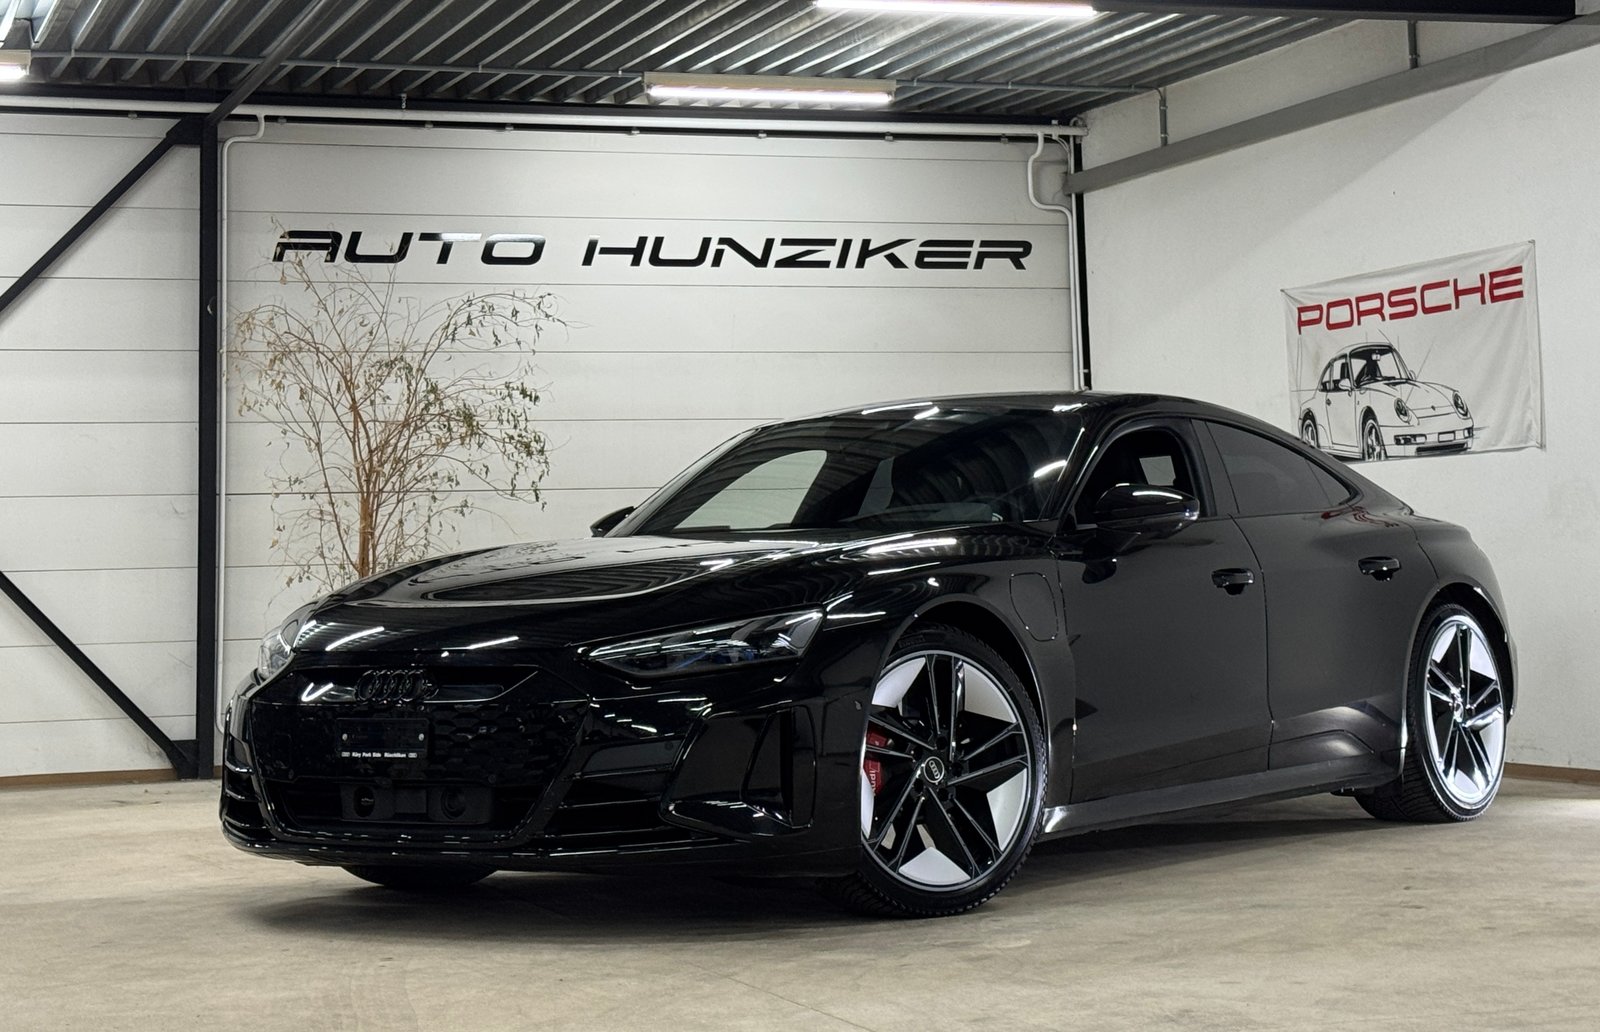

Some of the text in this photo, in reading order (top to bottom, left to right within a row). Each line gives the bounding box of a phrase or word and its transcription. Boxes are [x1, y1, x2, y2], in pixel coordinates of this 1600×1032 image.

[272, 230, 1033, 270] AUTO HUNZIKER
[1297, 265, 1524, 335] PORSCHE
